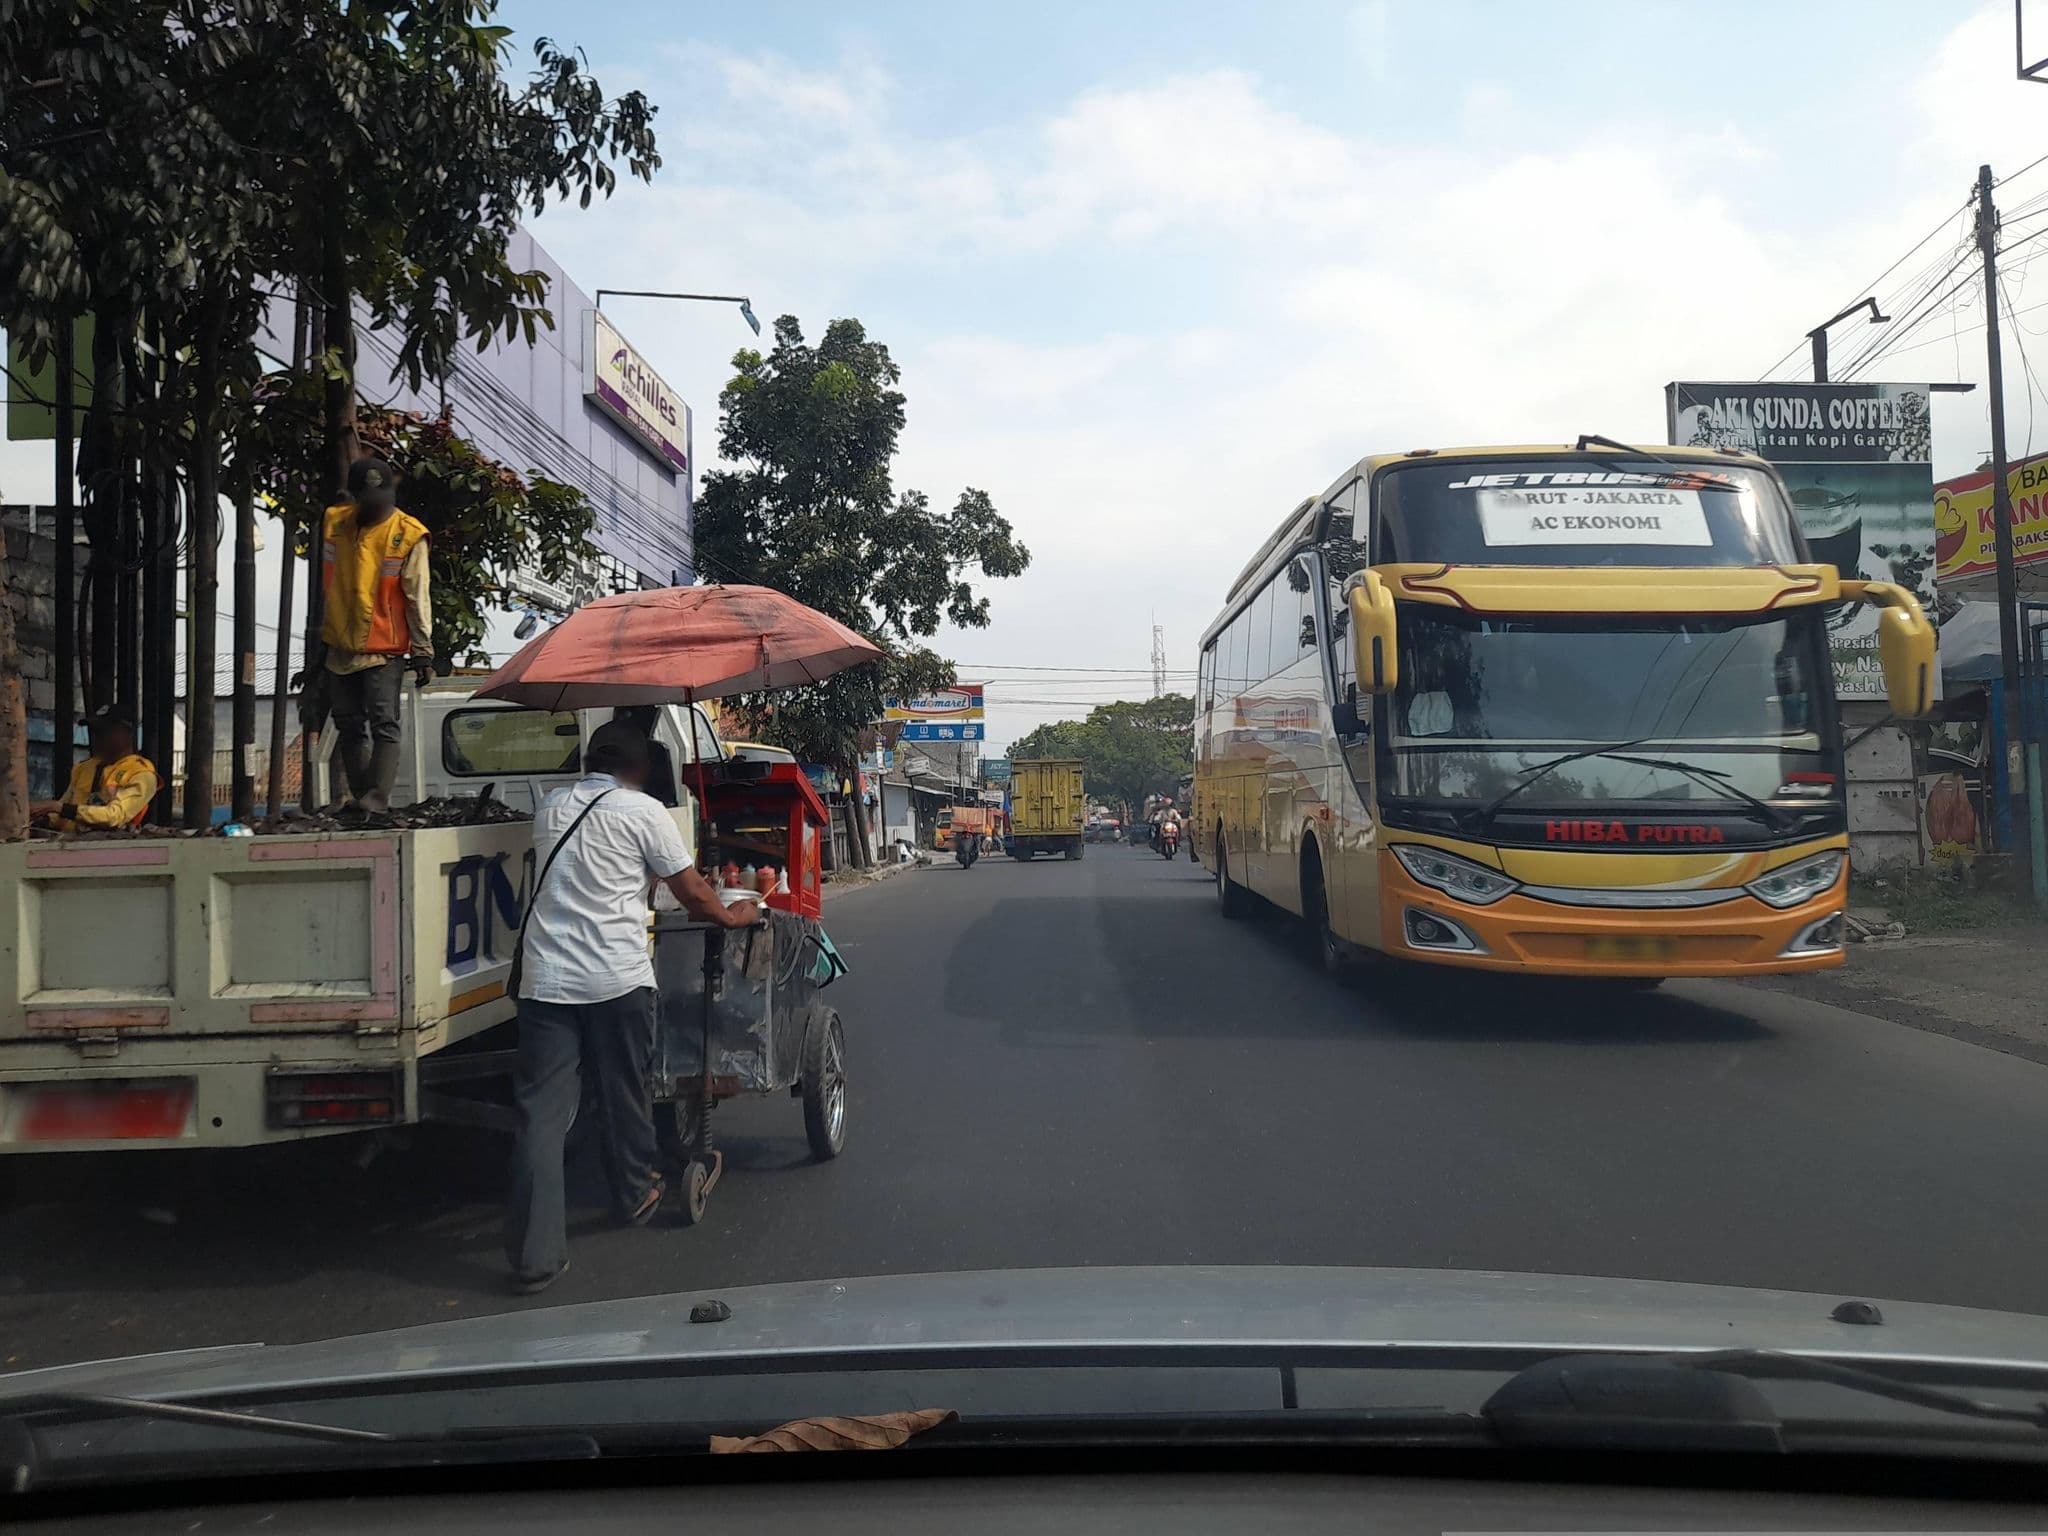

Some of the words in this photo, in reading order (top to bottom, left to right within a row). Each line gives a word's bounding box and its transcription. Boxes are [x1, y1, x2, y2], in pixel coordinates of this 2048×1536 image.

[611, 348, 676, 426] Achilles
[1711, 398, 1748, 429] AKI
[1753, 398, 1824, 430] SUNDA
[1829, 398, 1904, 430] COFFEE
[1806, 434, 1847, 449] Kopi
[1448, 472, 1657, 489] JETBUS
[1500, 492, 1567, 505] RUT
[1583, 492, 1682, 506] JAKARTA
[1531, 516, 1558, 530] AC
[1563, 516, 1662, 530] EKONOMI
[911, 696, 968, 708] ndomaret
[1546, 820, 1629, 842] HIBA
[1638, 825, 1724, 843] PUTRA
